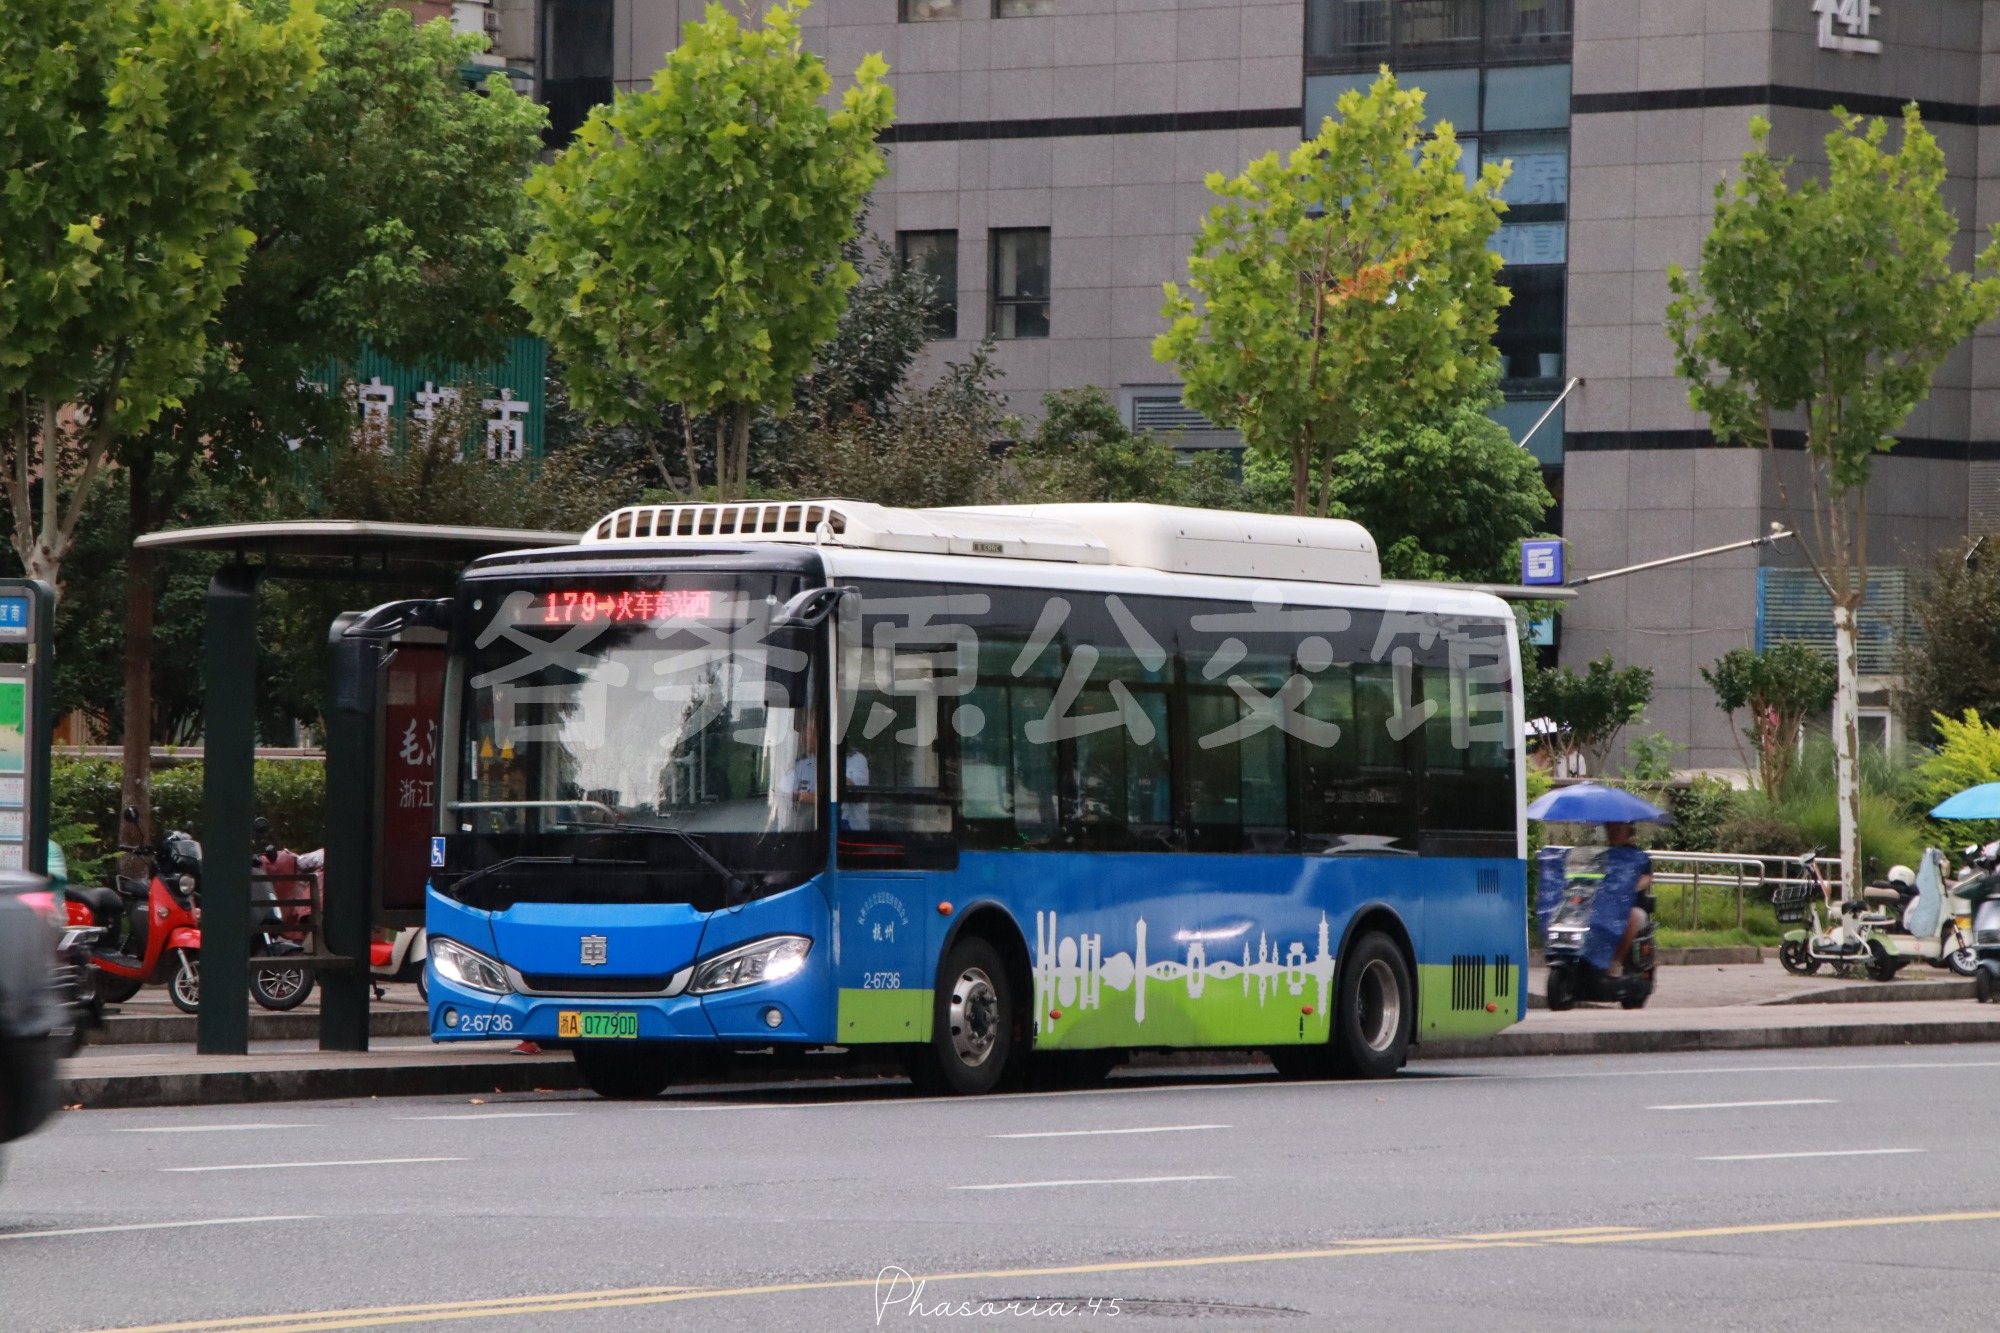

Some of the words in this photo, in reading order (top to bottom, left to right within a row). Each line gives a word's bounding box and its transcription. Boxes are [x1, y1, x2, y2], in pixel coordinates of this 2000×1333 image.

[545, 592, 596, 622] 179
[616, 591, 711, 621] 火车东站西
[400, 779, 434, 809] 浙江
[872, 921, 895, 943] 杭州
[864, 972, 900, 989] 2-6736
[461, 1014, 513, 1032] 2-6736
